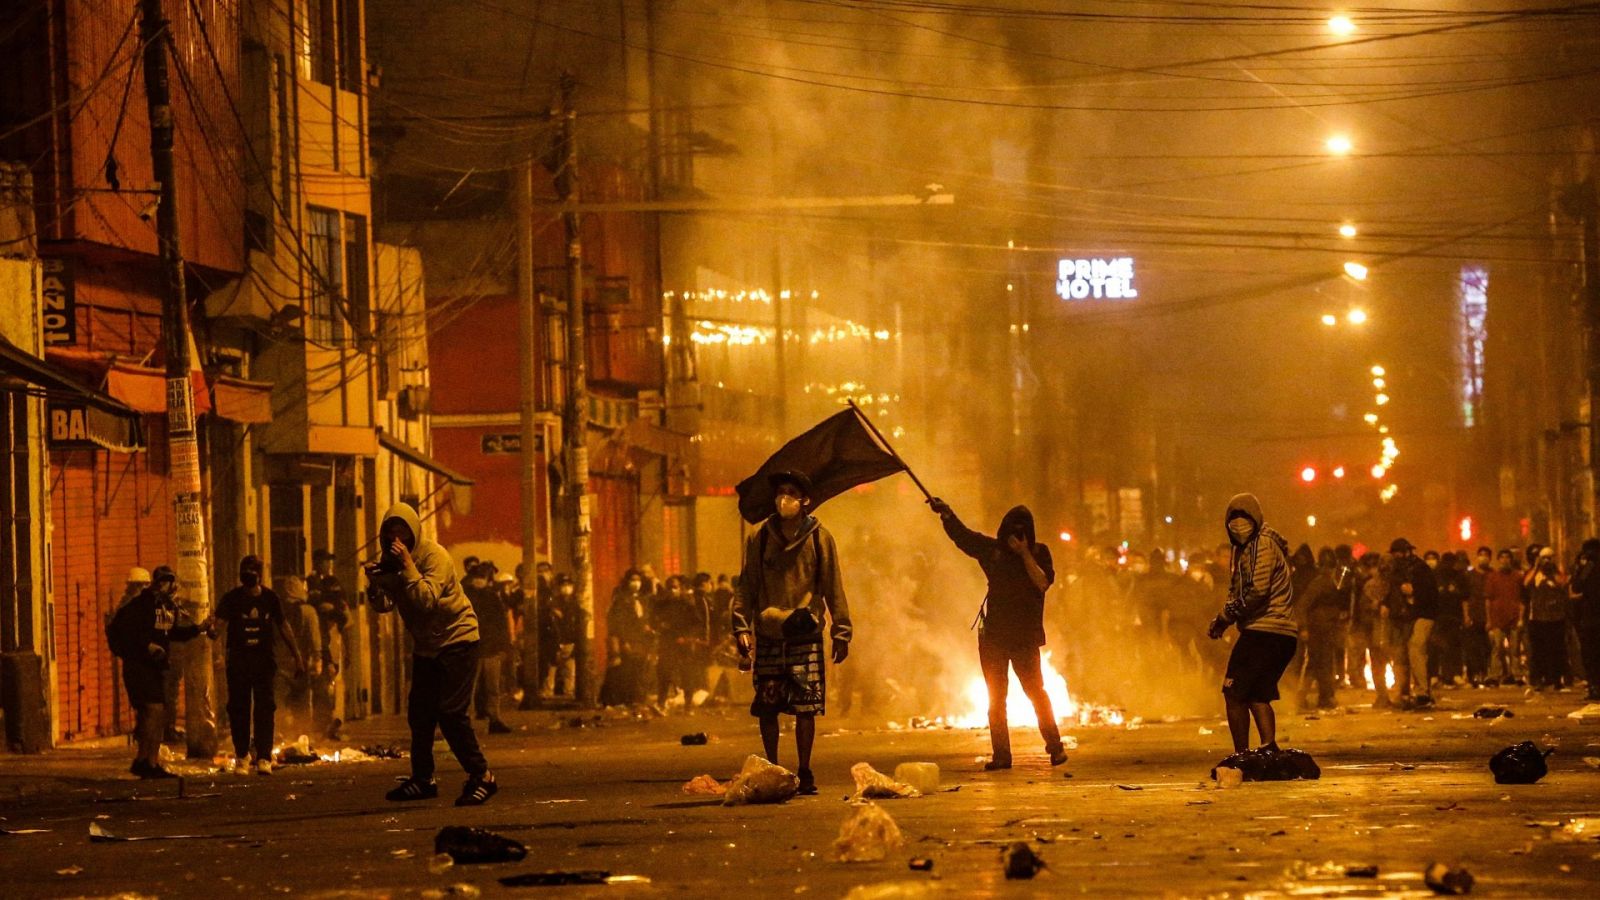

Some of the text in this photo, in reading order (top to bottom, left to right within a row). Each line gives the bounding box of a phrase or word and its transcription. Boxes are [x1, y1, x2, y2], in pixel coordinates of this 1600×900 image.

[1058, 257, 1134, 279] PRIME
[1056, 278, 1138, 300] HOTEL
[51, 409, 90, 440] BA
